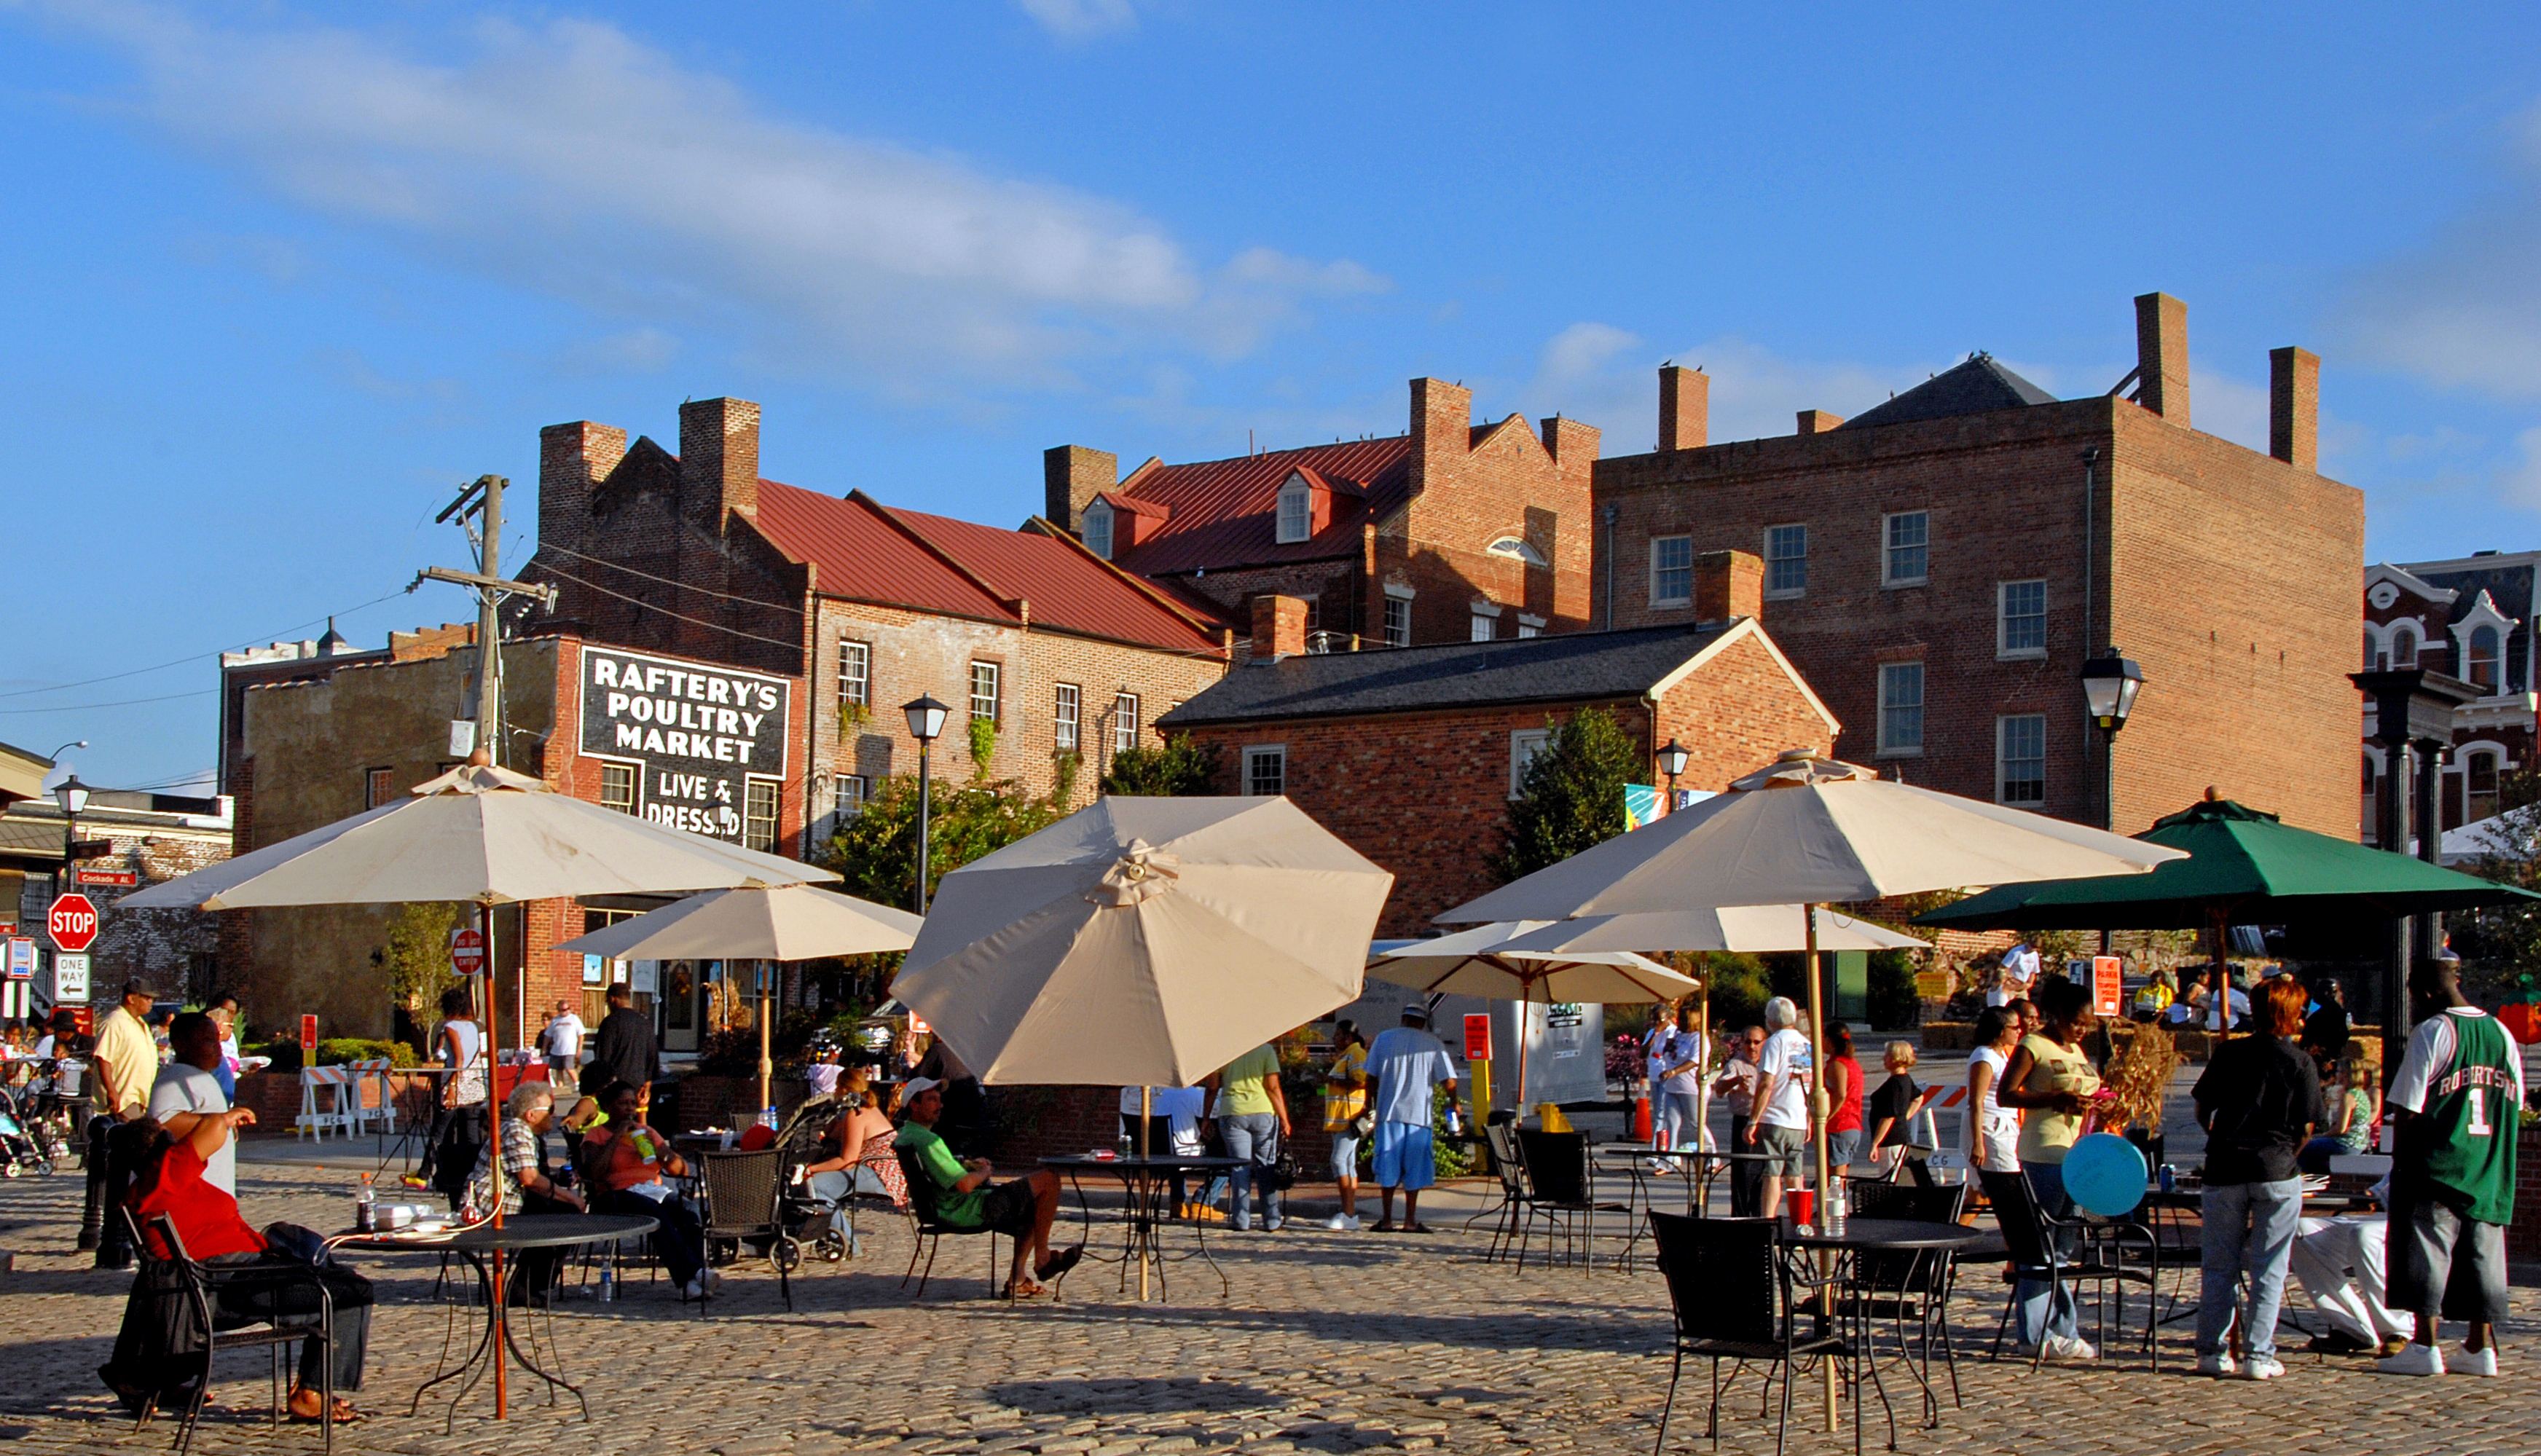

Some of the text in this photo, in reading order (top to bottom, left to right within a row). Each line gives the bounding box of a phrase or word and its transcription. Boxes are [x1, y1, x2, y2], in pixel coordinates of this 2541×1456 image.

[594, 658, 778, 711] RAFTERY'S
[608, 692, 764, 737] POULTRY
[616, 723, 755, 764] MARKET
[659, 772, 731, 803] LIVE &
[648, 803, 740, 836] DRESSD
[82, 874, 115, 883] Cockade
[52, 911, 95, 934] STOP
[457, 938, 466, 946] DO
[60, 959, 84, 969] ONE
[60, 972, 85, 982] WAY
[458, 958, 478, 966] ENTR
[2438, 1064, 2518, 1102] ROBRTSN
[2467, 1087, 2493, 1136] 1
